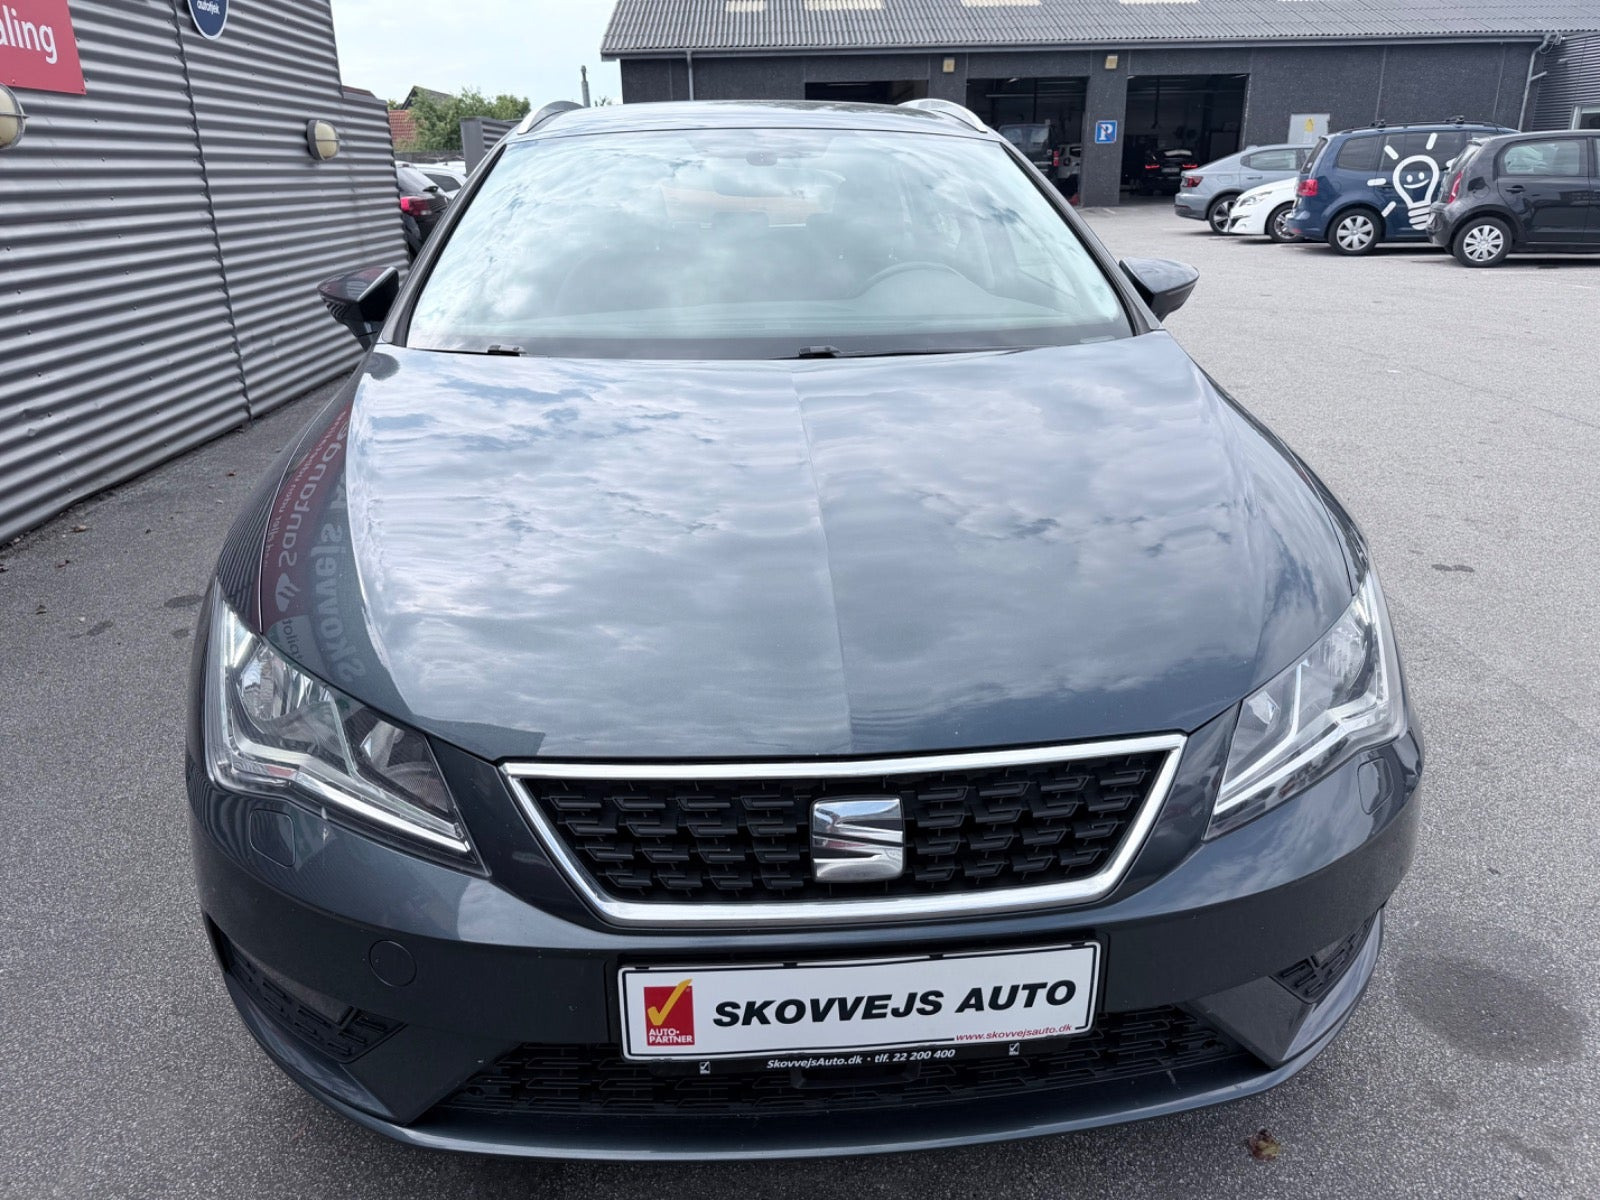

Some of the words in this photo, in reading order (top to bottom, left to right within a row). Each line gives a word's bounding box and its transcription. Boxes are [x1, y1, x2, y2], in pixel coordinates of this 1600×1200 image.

[1099, 123, 1114, 141] P
[712, 990, 945, 1028] SKOVVEJS
[954, 979, 1077, 1014] AUTO
[649, 1035, 693, 1044] PARTNER
[956, 1023, 1072, 1042] www.skovvejsauto.dk
[766, 1054, 864, 1070] SkovvejsAuto.dk
[892, 1053, 908, 1062] 22
[909, 1050, 932, 1061] 200
[933, 1048, 956, 1059] 400
